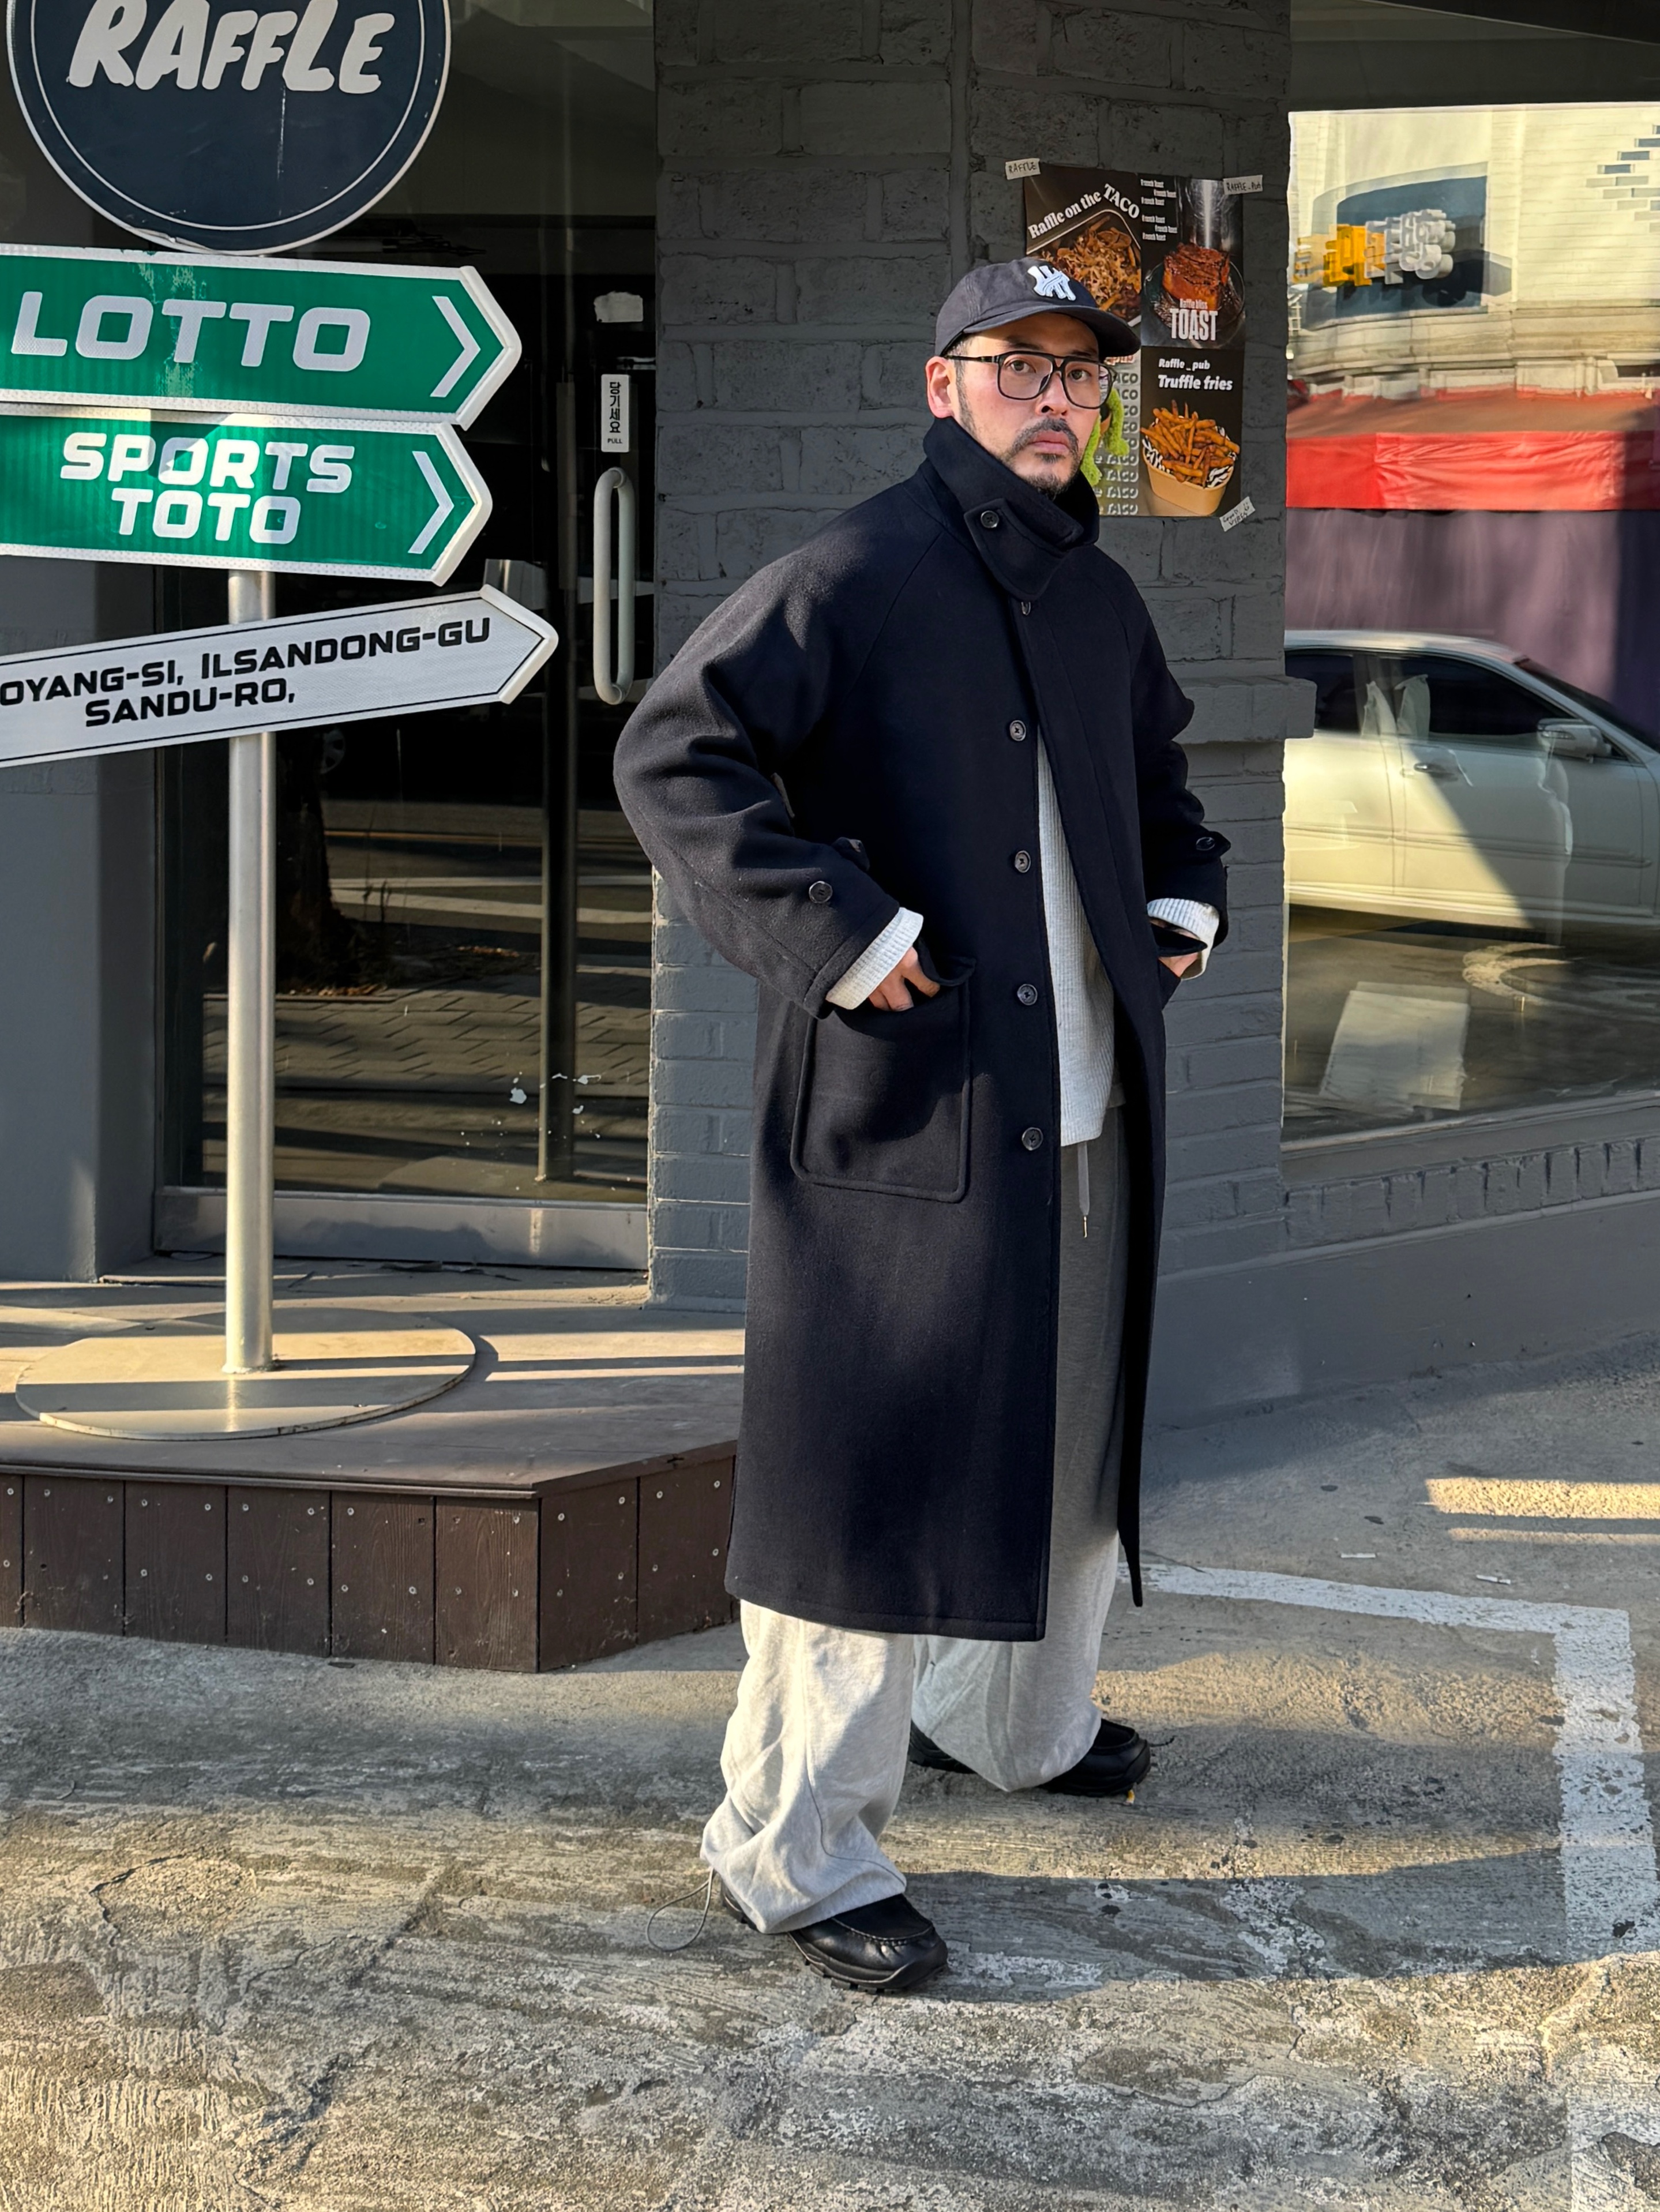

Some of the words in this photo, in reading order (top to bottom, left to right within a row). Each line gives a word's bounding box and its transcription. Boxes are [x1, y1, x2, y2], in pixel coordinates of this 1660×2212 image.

[66, 0, 396, 93] RAFFLE
[1028, 212, 1065, 239] Raffle
[1065, 203, 1082, 218] on
[1080, 191, 1102, 209] the
[1103, 183, 1140, 219] TACO
[11, 291, 371, 372] LOTTO
[1170, 308, 1218, 341] TOAST
[610, 382, 621, 433] 당기세요
[1158, 374, 1201, 389] Truffle
[1204, 375, 1233, 390] fries
[60, 431, 355, 493] SPORTS
[111, 487, 302, 545] TOTO
[201, 617, 490, 679] ILSANDONG-GU
[85, 677, 295, 727] SANDU-RO,
